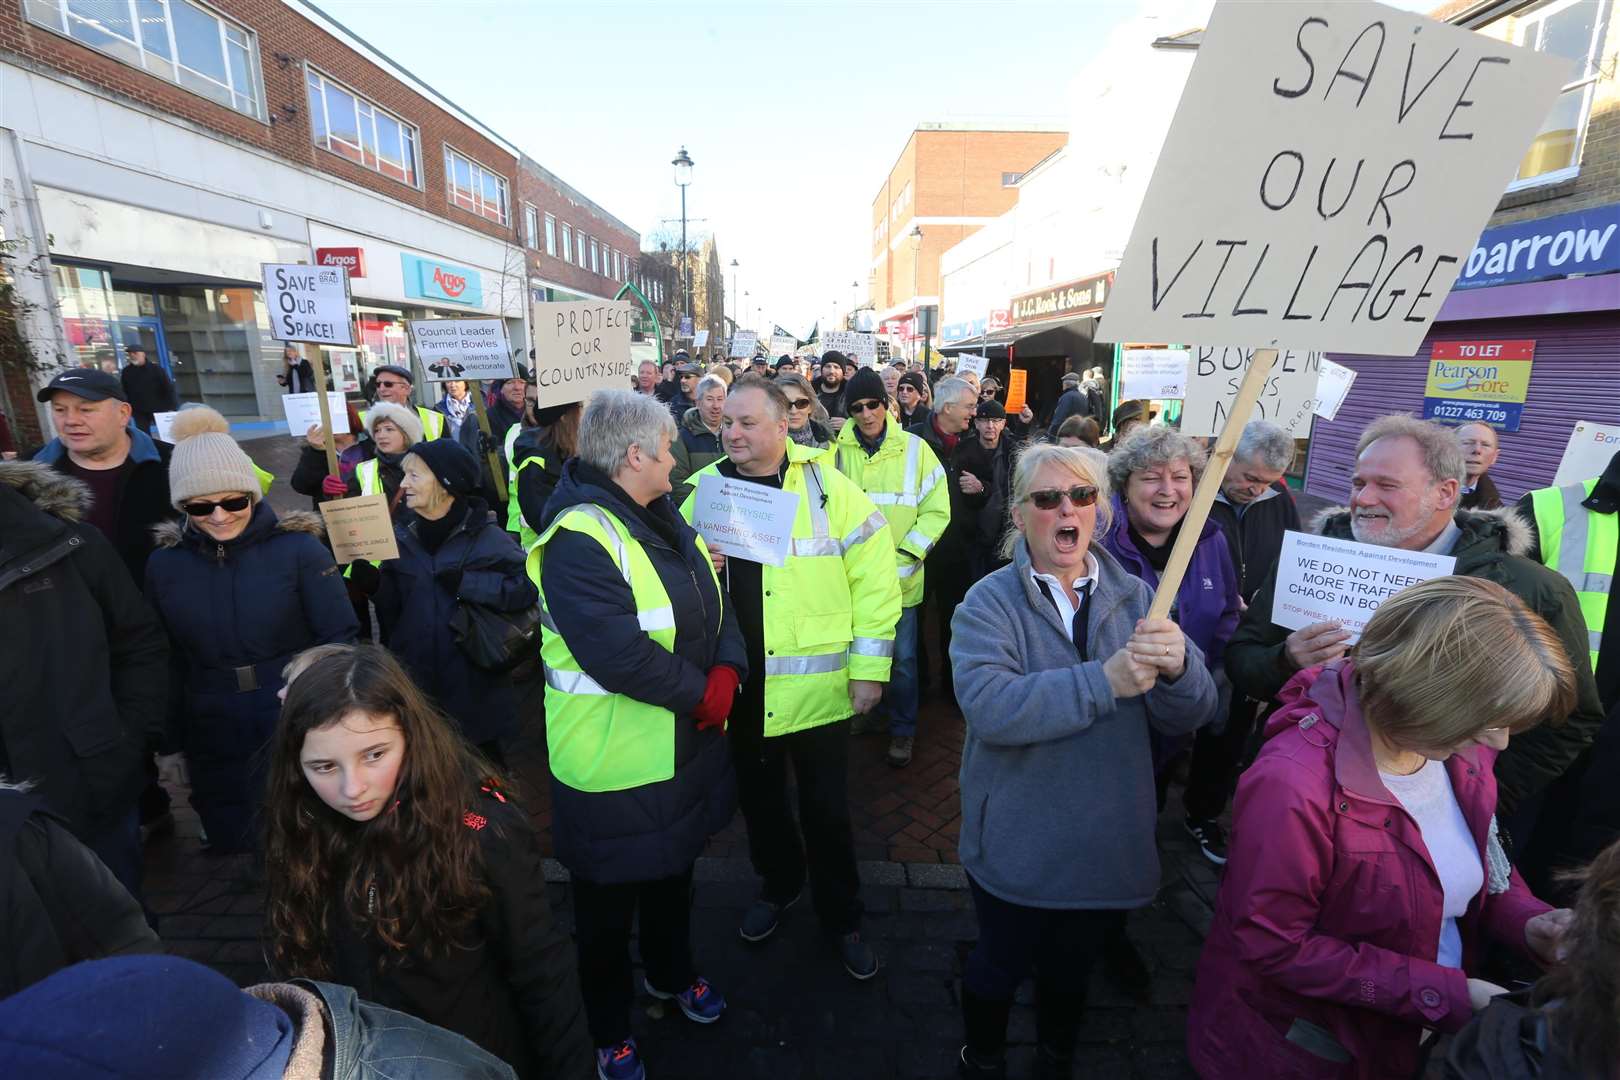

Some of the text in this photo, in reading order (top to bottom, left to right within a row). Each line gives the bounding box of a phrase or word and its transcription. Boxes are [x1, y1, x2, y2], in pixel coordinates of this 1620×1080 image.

[1273, 16, 1511, 140] SAVE
[1260, 150, 1416, 230] OUR
[323, 253, 357, 266] Argos
[276, 268, 316, 291] SAVE
[433, 267, 466, 296] Argos
[1151, 235, 1458, 324] VILLAGE
[280, 291, 316, 314] OUR
[418, 326, 495, 337] Council Leader
[557, 307, 630, 337] PROTECT
[422, 340, 498, 349] Farmer Bowles
[571, 337, 602, 356] OUR
[1459, 345, 1503, 357] TO LET
[540, 361, 631, 387] COUNTRYSIDE
[1434, 361, 1498, 379] Pearson
[1466, 377, 1509, 393] Gore
[1433, 406, 1507, 421] 01227 463 709
[710, 501, 776, 522] COUNTRYSIDE
[703, 522, 750, 538] VANISHING
[751, 531, 783, 545] ASSET
[1321, 543, 1357, 556] Residents
[1359, 550, 1388, 561] Against
[1388, 554, 1438, 569] Development
[1297, 557, 1319, 570] WE
[1322, 561, 1344, 575] DO
[1347, 567, 1380, 581] NOT
[1302, 572, 1345, 590] MORE
[1288, 583, 1336, 602] CHAOS
[1339, 594, 1354, 607] IN
[1282, 602, 1302, 614] STOP
